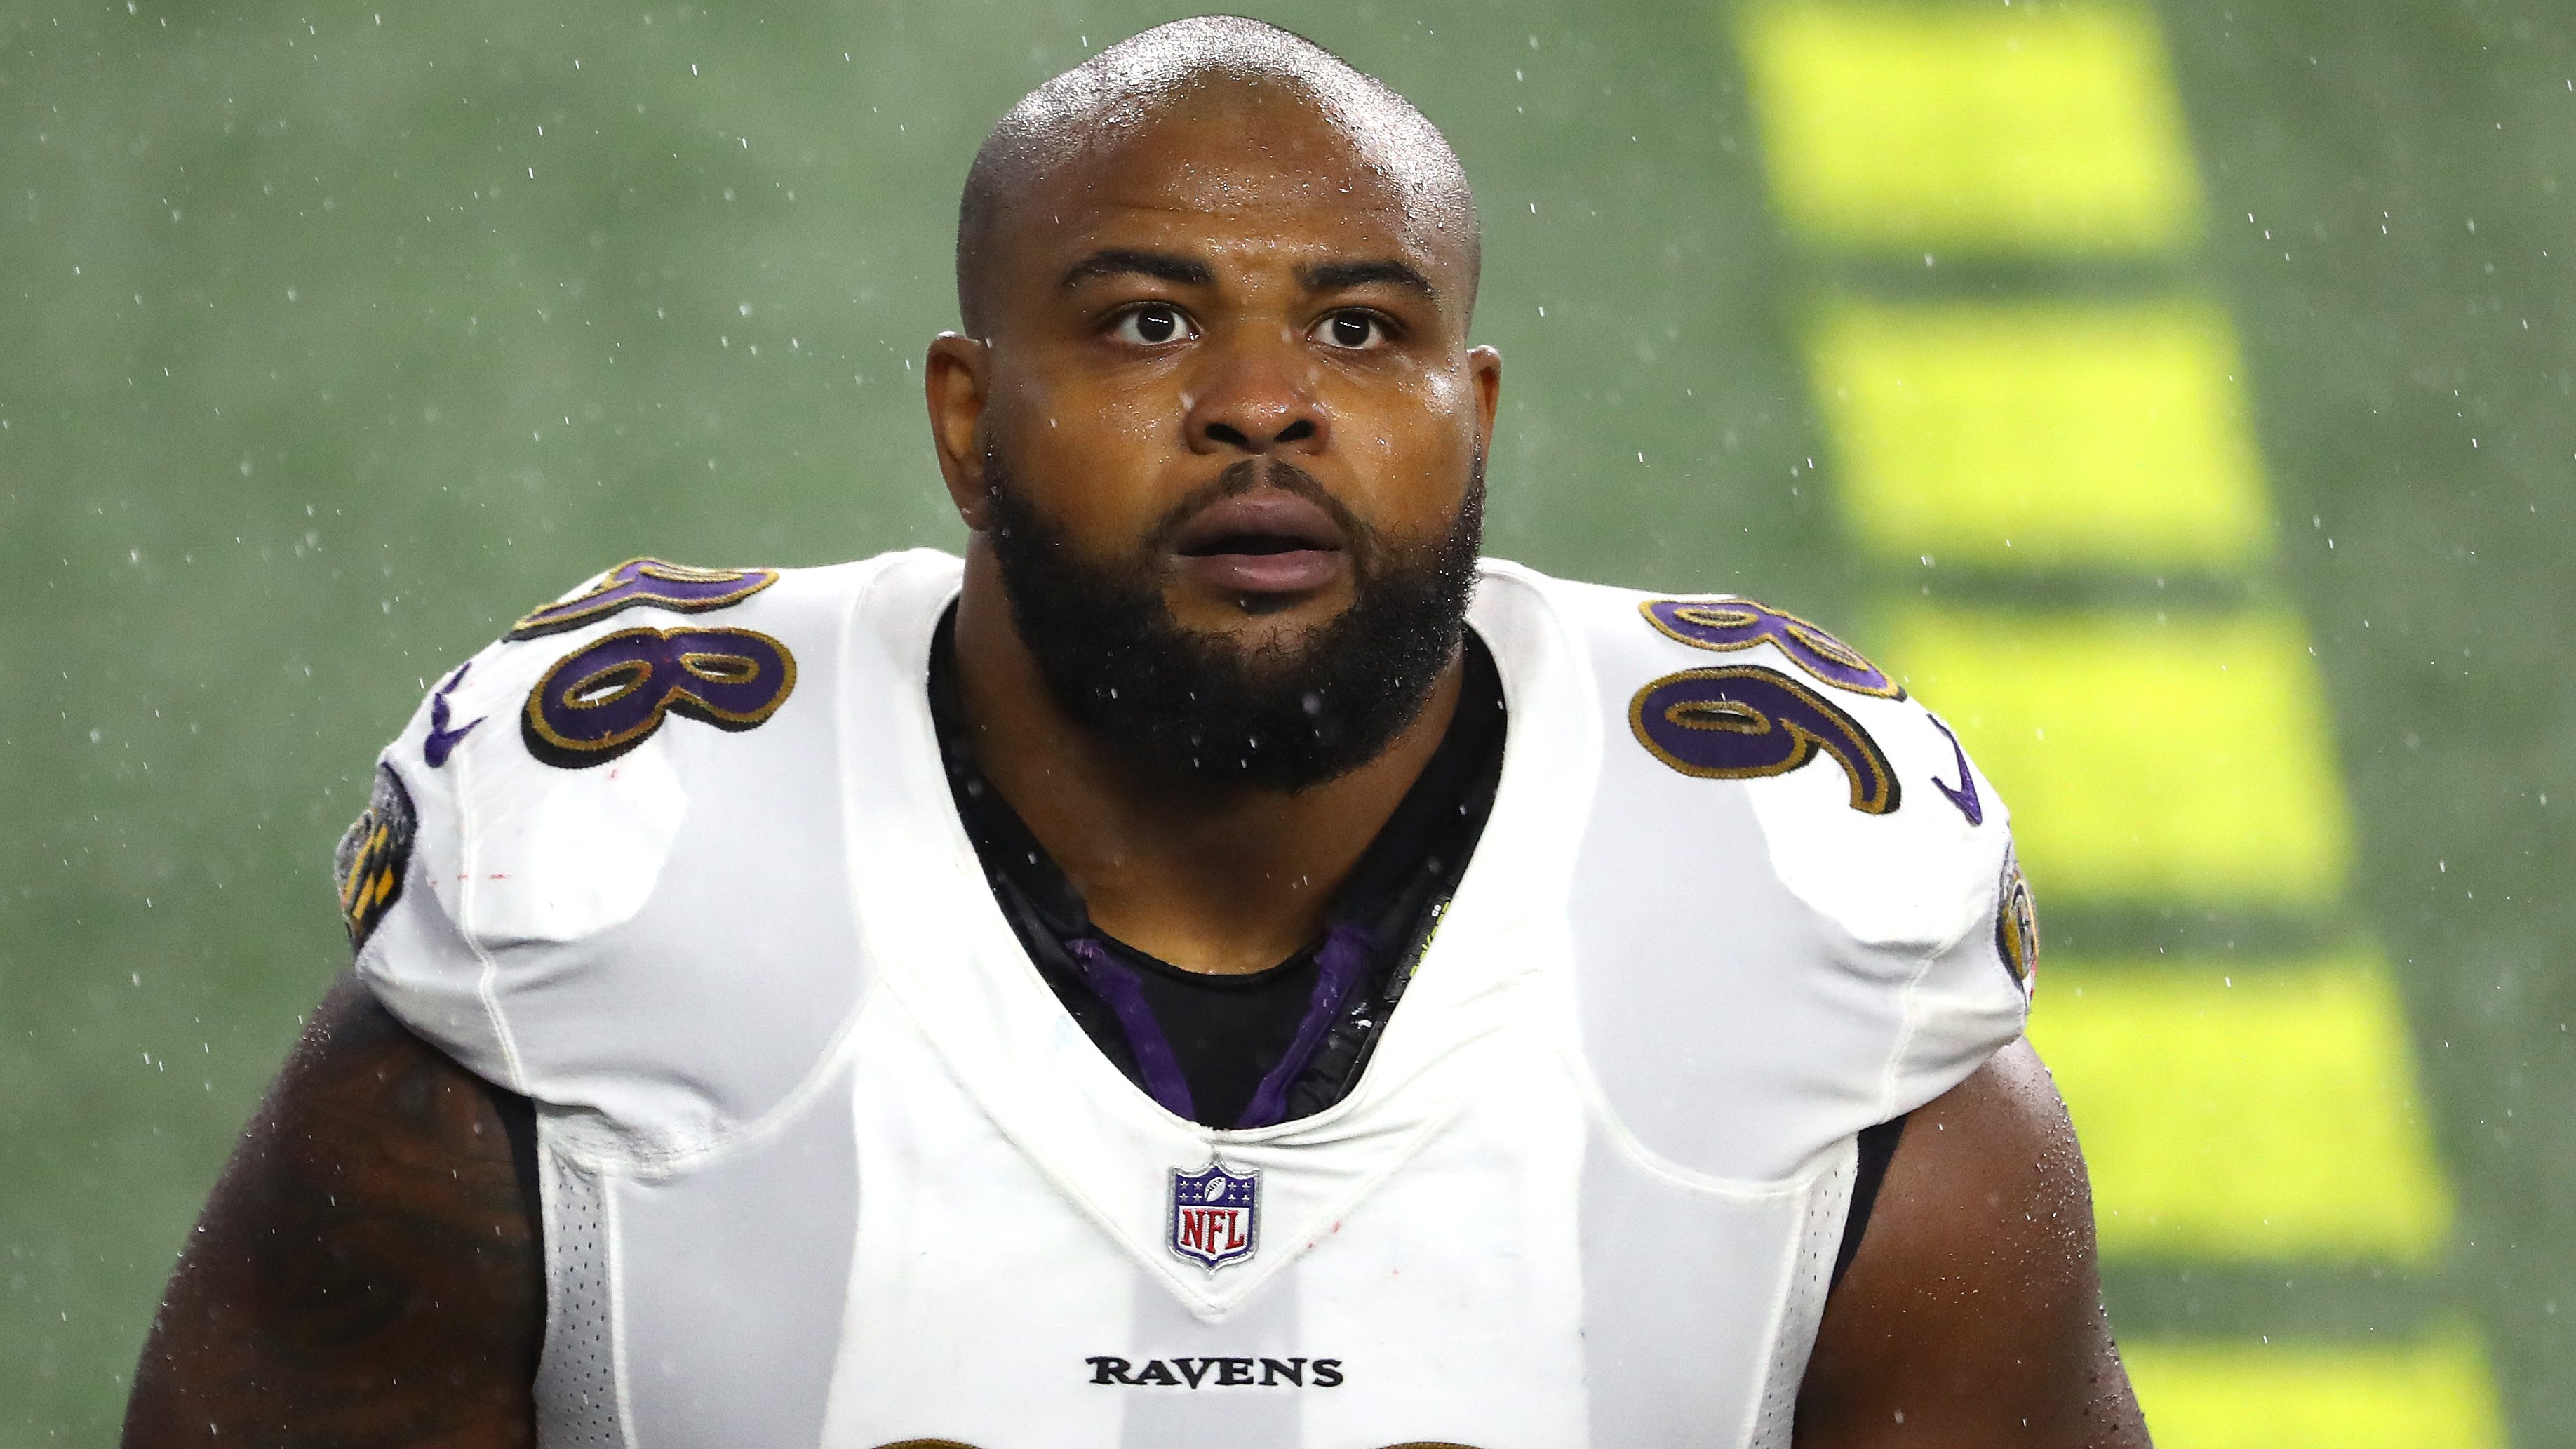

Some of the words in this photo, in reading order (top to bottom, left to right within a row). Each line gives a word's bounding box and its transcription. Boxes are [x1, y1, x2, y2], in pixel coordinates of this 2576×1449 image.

[1628, 599, 1907, 815] 98
[1180, 1209, 1245, 1255] NFL
[1085, 1356, 1344, 1390] RAVENS
